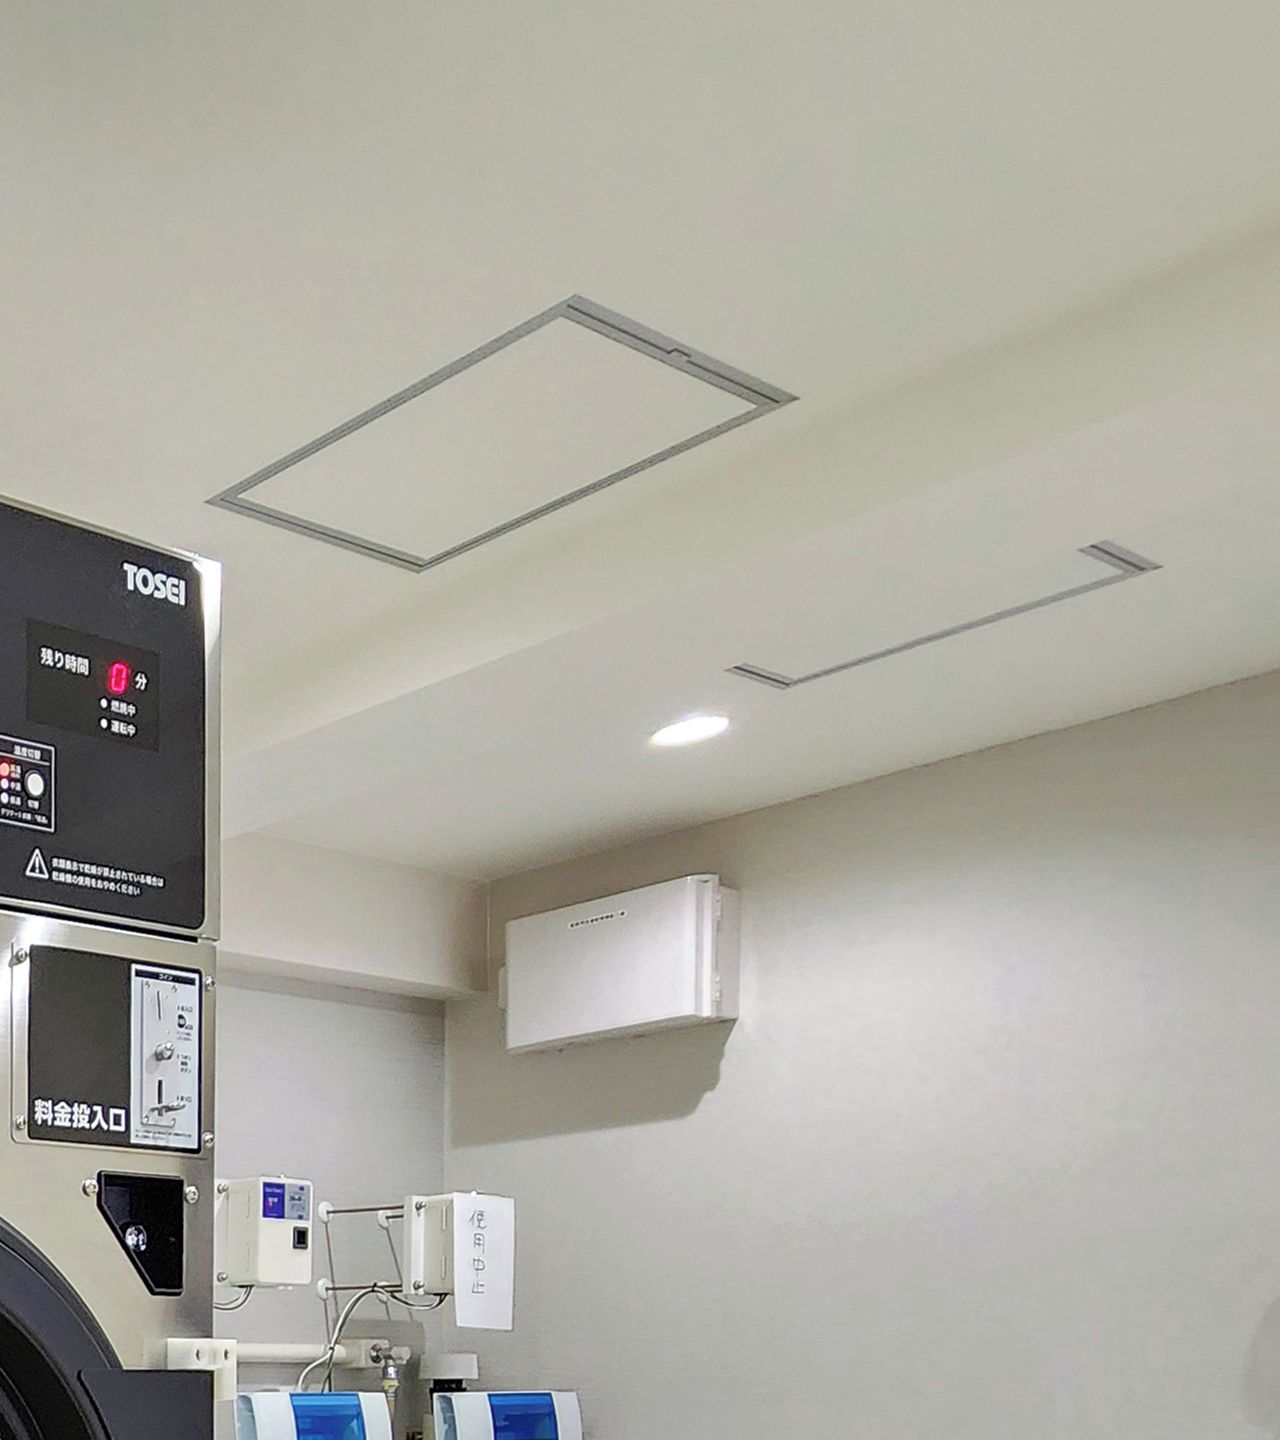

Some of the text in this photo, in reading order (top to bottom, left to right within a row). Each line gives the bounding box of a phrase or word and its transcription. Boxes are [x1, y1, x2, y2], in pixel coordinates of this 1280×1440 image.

[123, 561, 186, 607] TOSEI
[40, 646, 148, 693] 残り時間 0 分
[34, 1097, 127, 1133] 料金投入口
